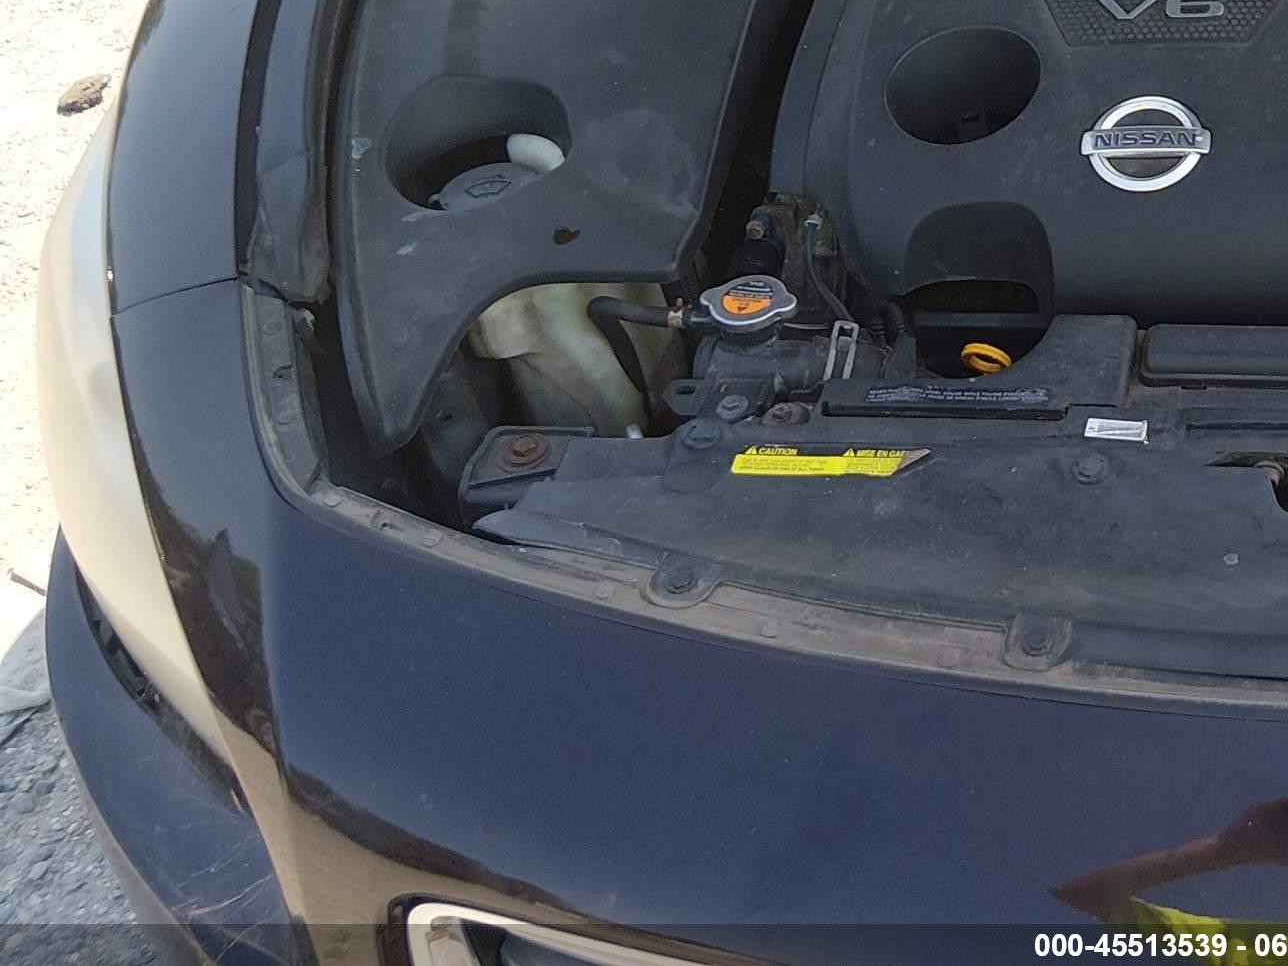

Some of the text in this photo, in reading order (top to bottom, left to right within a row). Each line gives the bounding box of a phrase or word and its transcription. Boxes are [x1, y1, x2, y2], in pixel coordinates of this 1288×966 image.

[1093, 129, 1198, 148] NISSAN
[758, 447, 798, 456] CAUTION
[856, 449, 876, 457] MISE
[876, 449, 889, 458] EN
